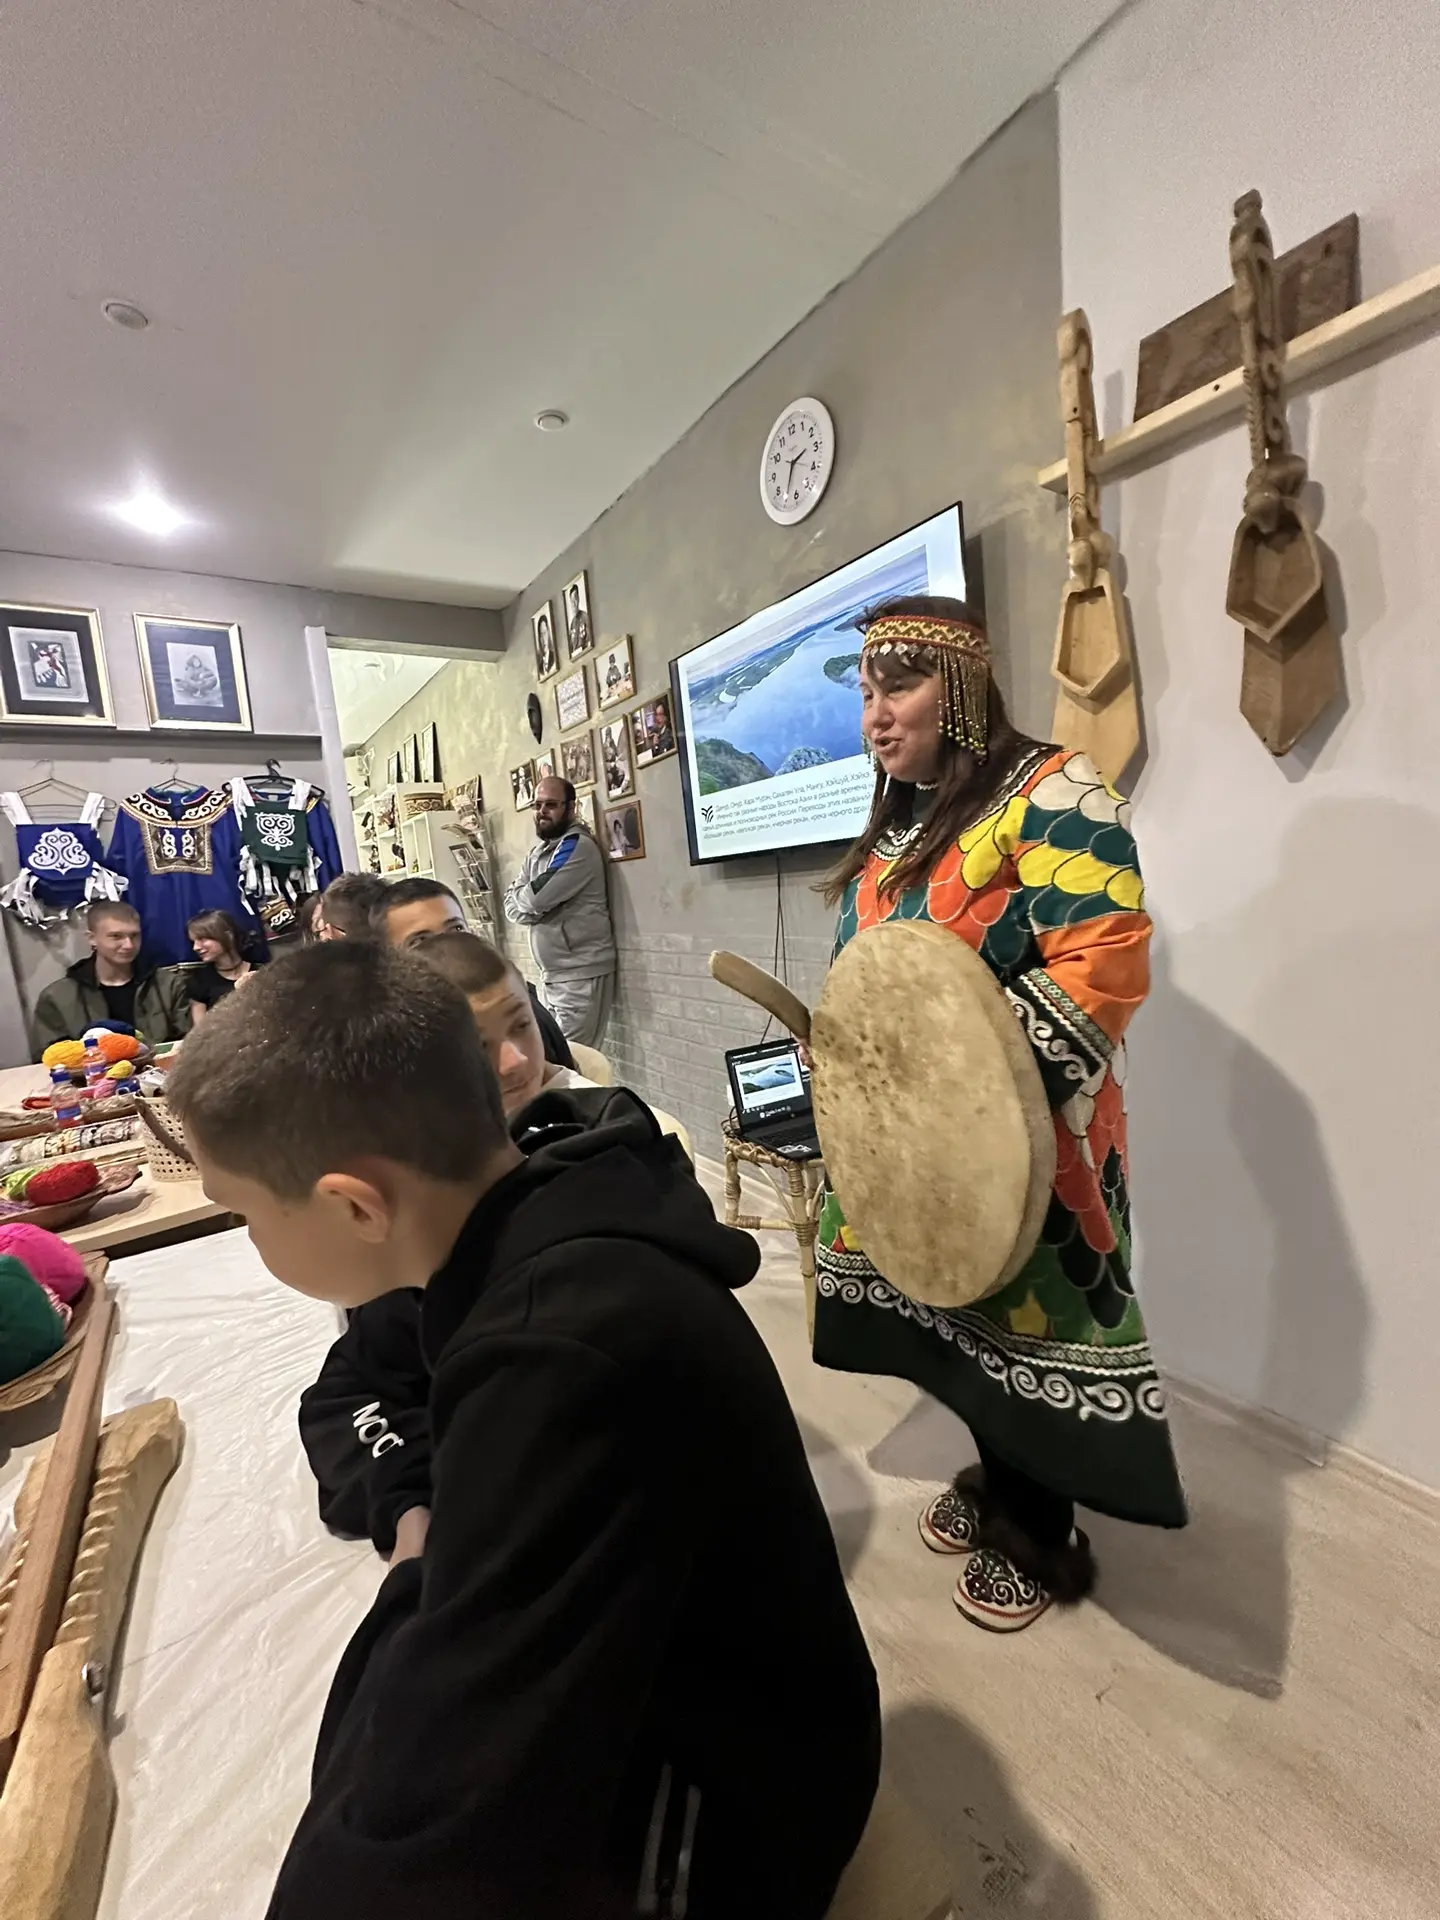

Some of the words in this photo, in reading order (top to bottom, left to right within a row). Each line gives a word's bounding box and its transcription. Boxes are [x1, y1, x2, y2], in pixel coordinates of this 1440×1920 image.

[788, 423, 796, 436] 12
[809, 426, 814, 438] 2
[779, 436, 786, 448] 11
[813, 440, 819, 452] 3
[773, 453, 781, 464] 10
[810, 461, 816, 471] 4
[771, 472, 776, 483] 9
[776, 486, 781, 496] 8
[794, 489, 799, 500] 6
